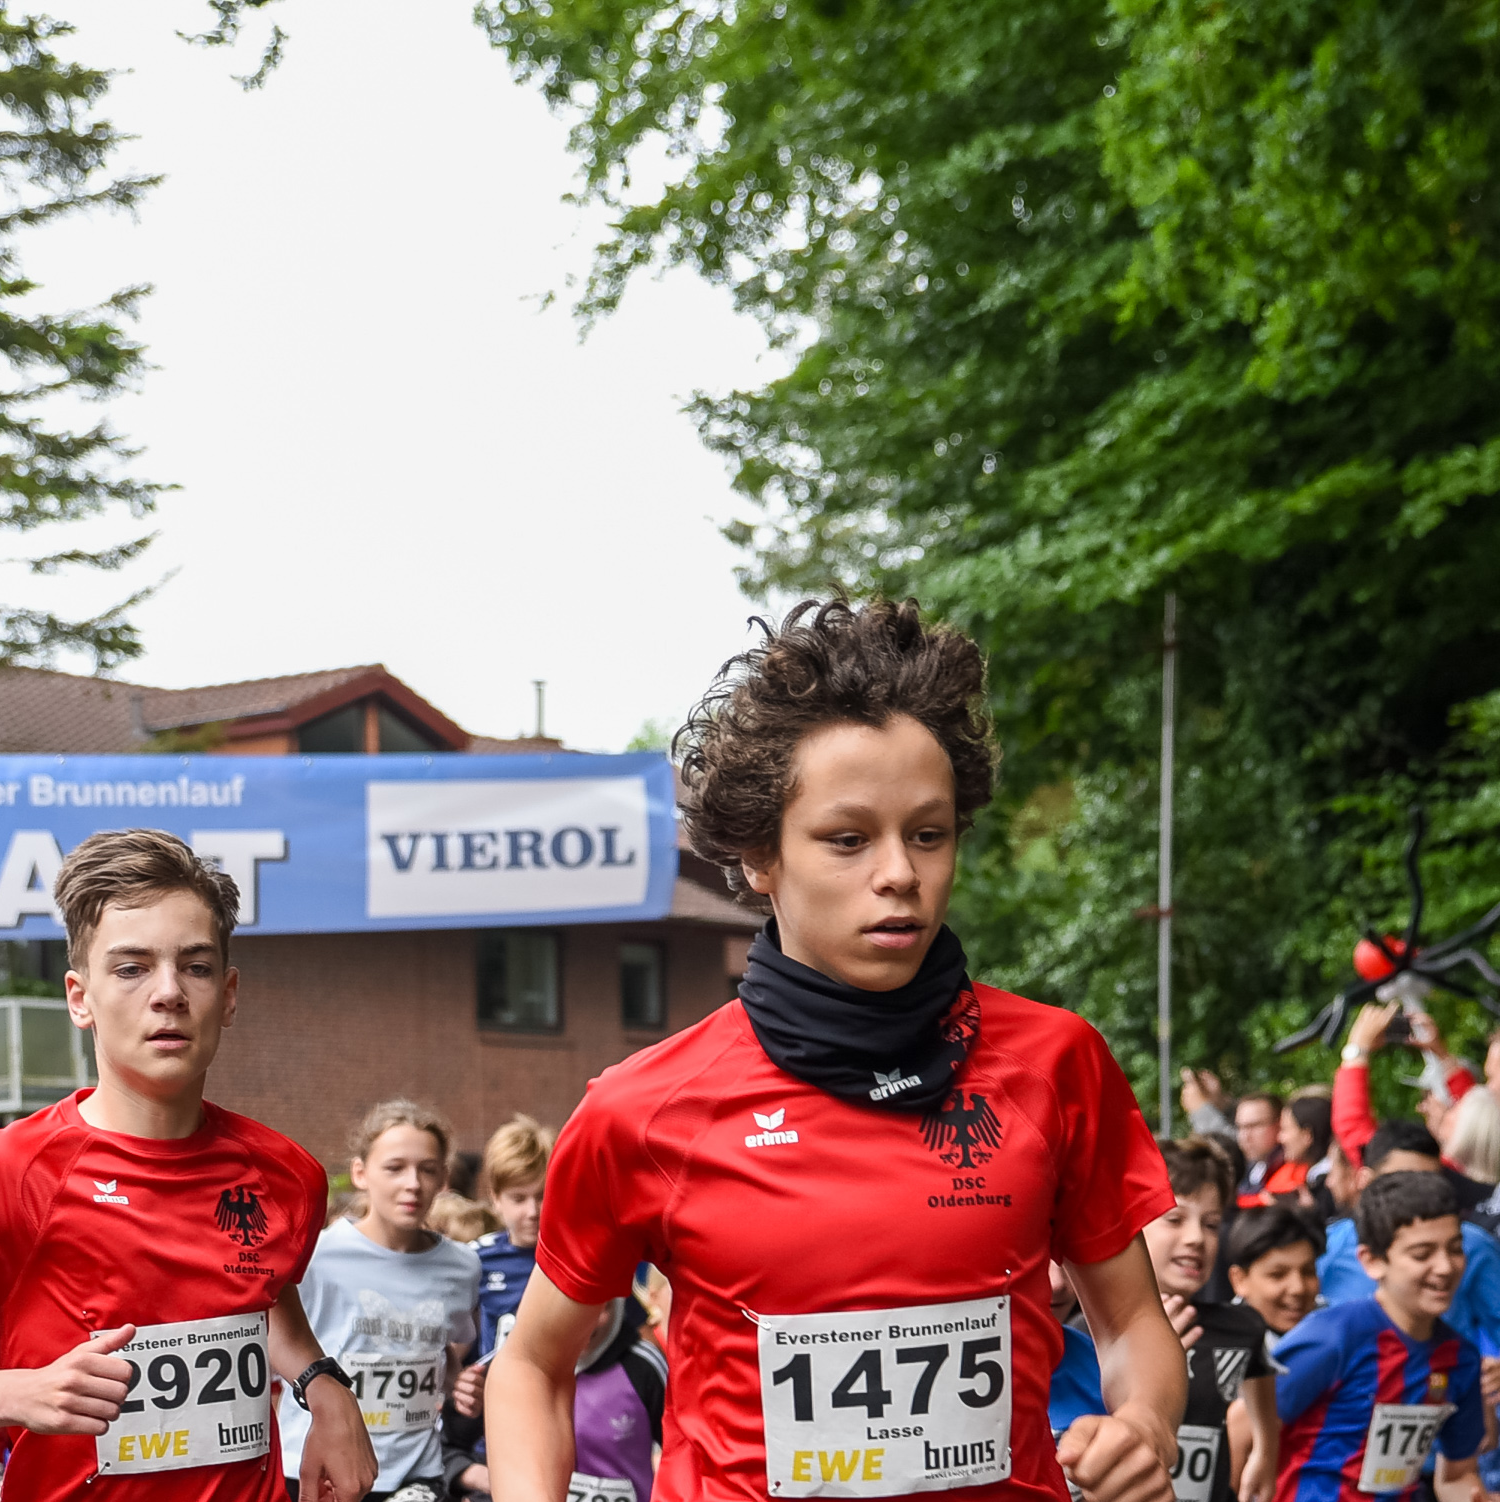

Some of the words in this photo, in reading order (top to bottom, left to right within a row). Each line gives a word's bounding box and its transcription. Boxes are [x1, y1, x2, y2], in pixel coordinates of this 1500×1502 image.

[28, 773, 246, 807] Brunnenlauf
[380, 826, 637, 873] VIEROL
[868, 1074, 922, 1101] erima
[744, 1128, 799, 1148] erima
[951, 1176, 987, 1191] DSC
[926, 1194, 1013, 1209] Oldenburg
[223, 1263, 276, 1278] Oldenburg
[238, 1252, 260, 1263] DSC
[116, 1335, 184, 1353] erstener
[187, 1323, 261, 1346] Brunnenlauf
[775, 1329, 883, 1346] Everstener
[888, 1313, 998, 1340] Brunnenlauf
[350, 1366, 437, 1400] 1794
[772, 1335, 1005, 1423] 1475
[362, 1411, 391, 1427] WE
[866, 1425, 925, 1441] Lasse
[117, 1429, 190, 1462] EWE
[217, 1421, 265, 1447] bruns
[791, 1448, 886, 1483] EWE
[924, 1439, 996, 1471] bruns
